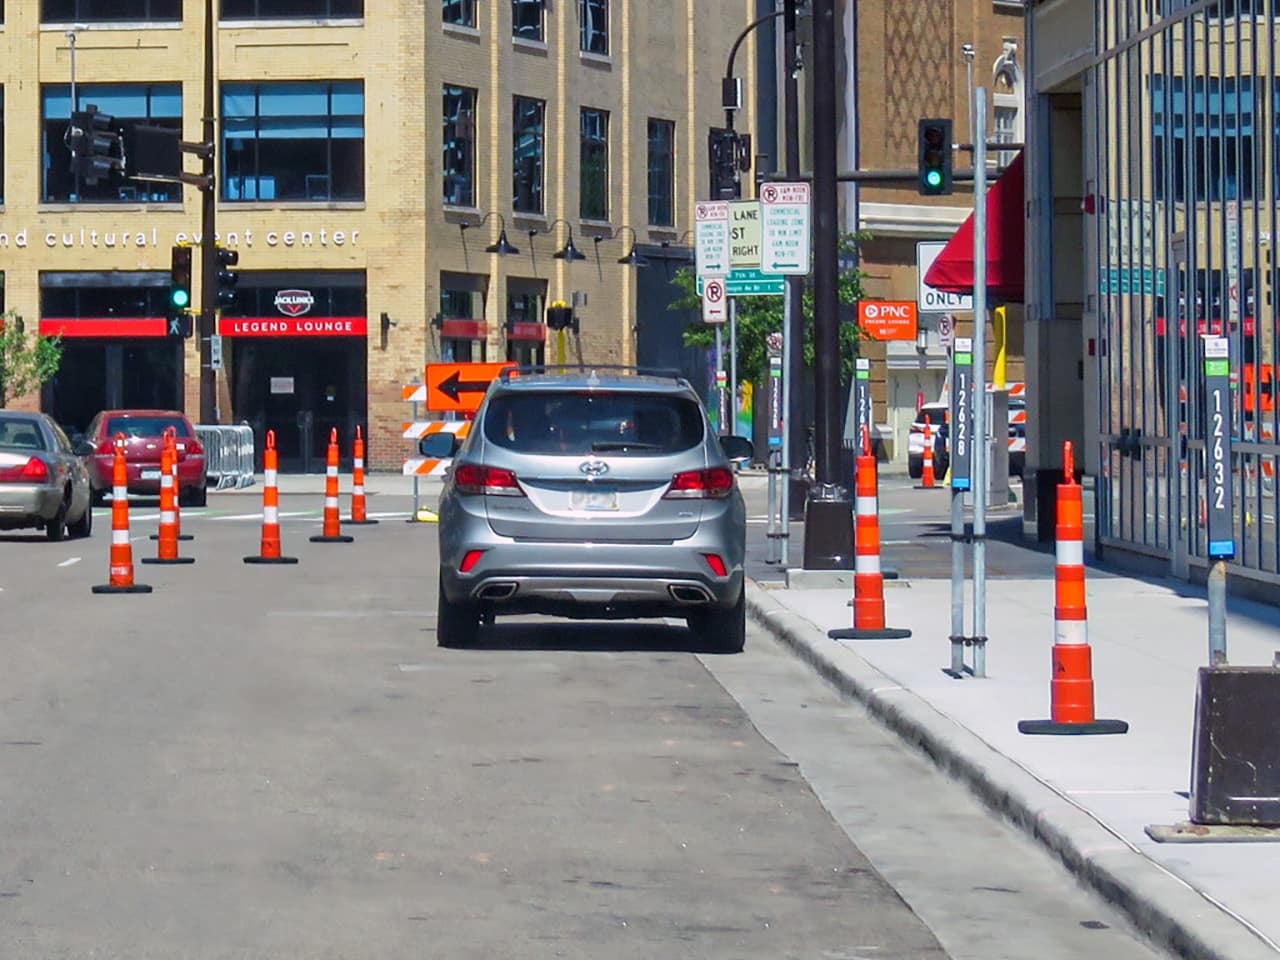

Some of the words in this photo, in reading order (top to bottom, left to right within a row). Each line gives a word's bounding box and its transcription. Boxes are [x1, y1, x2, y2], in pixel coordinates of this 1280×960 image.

[734, 209, 758, 221] LANE
[44, 227, 157, 248] cultural
[266, 228, 360, 247] center
[731, 227, 745, 240] ST
[732, 245, 759, 256] RIGHT
[925, 292, 963, 306] ONLY
[880, 305, 911, 318] PNC
[234, 322, 288, 332] LEGEND
[296, 321, 353, 331] LOUNGE
[957, 373, 967, 456] 12628
[1213, 389, 1225, 509] 12632
